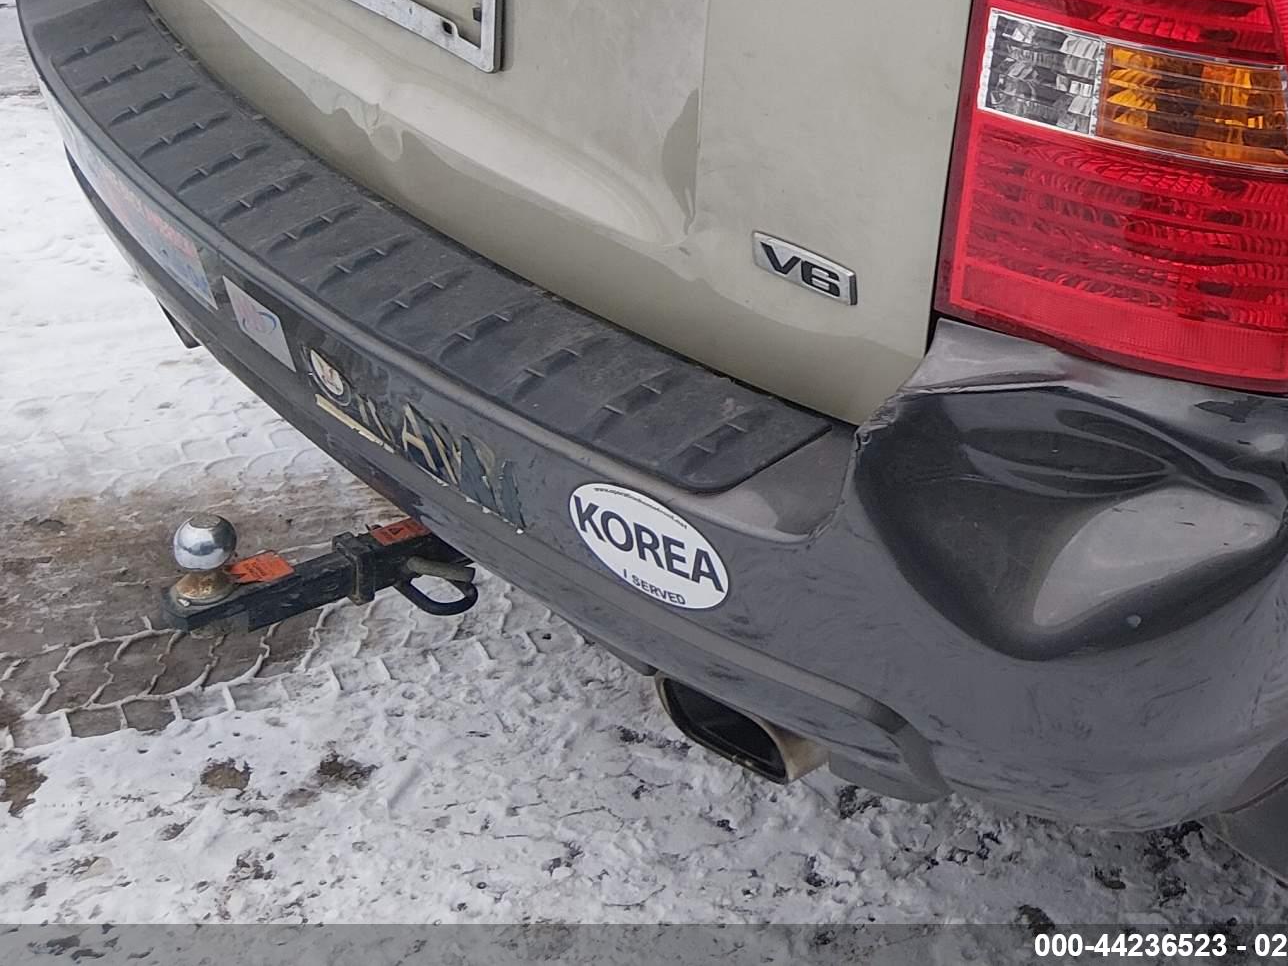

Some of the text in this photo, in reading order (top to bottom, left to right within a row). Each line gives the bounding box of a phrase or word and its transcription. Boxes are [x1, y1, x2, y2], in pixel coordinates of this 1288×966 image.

[759, 240, 841, 298] V6
[573, 494, 725, 594] KOREA
[622, 568, 687, 606] I SERVED
